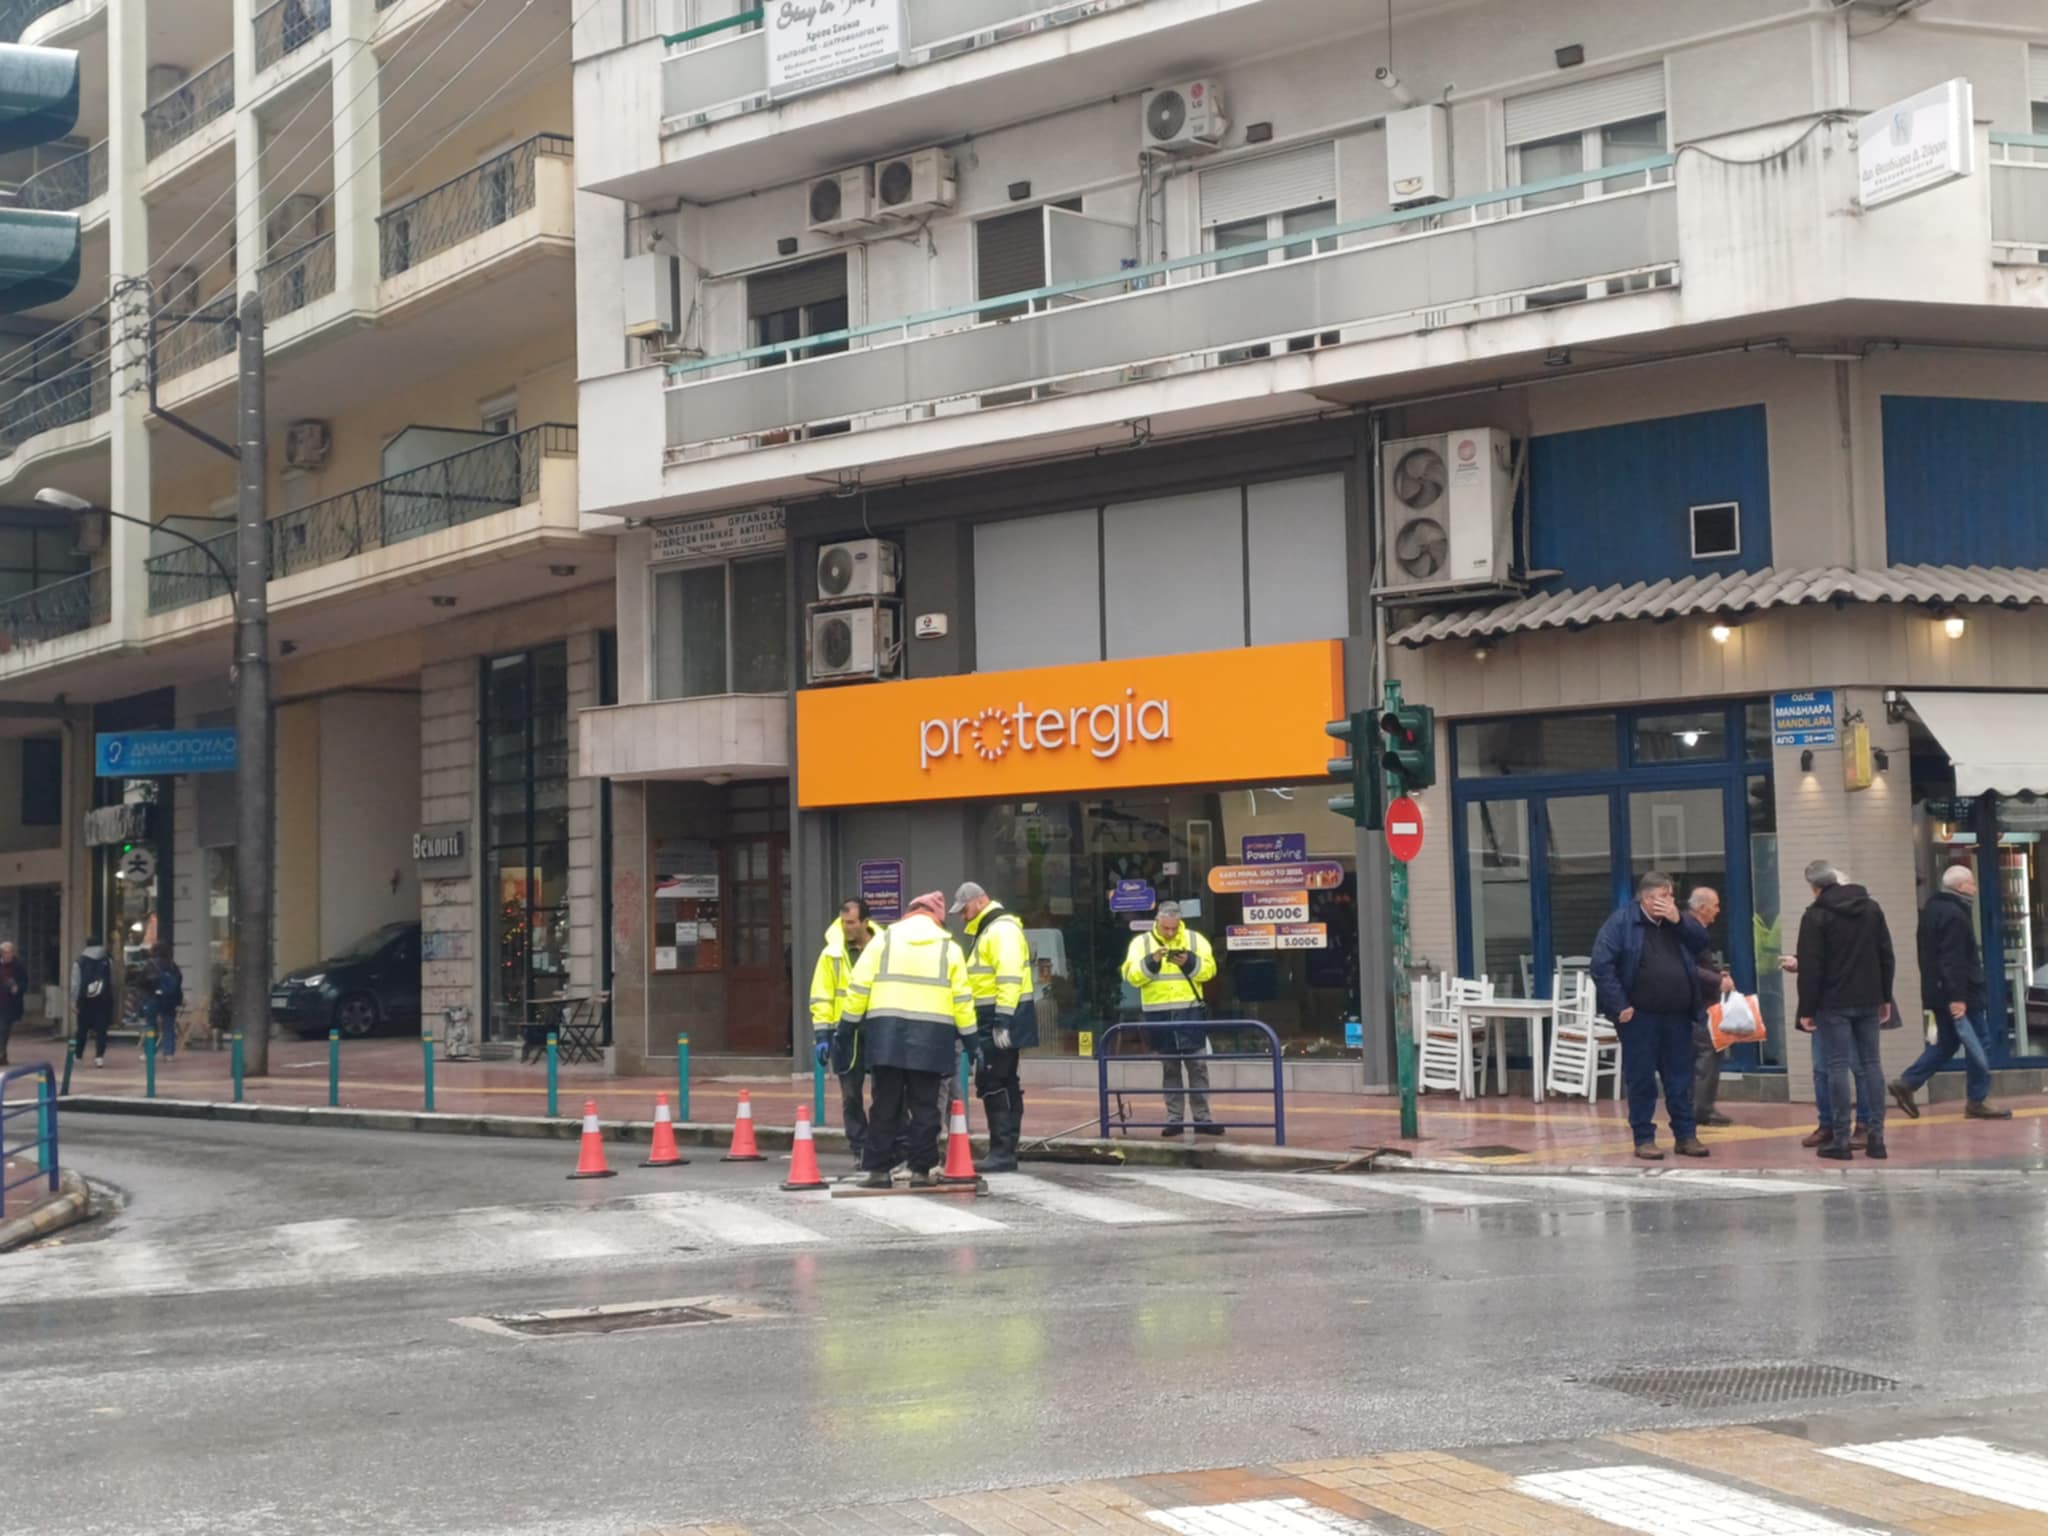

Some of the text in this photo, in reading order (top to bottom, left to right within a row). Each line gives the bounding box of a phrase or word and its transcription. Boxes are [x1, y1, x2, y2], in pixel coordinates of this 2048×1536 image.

[1192, 99, 1203, 109] LG
[1792, 693, 1816, 702] ΟΔΟΣ
[1776, 704, 1832, 717] ΜΑΝΔΗΛΑΡΑ
[1777, 717, 1832, 728] MANDILARA
[920, 688, 1170, 769] protergia
[1246, 849, 1302, 861] Powergiving
[1250, 907, 1302, 920] 50.000€
[1284, 937, 1318, 946] 5.000€
